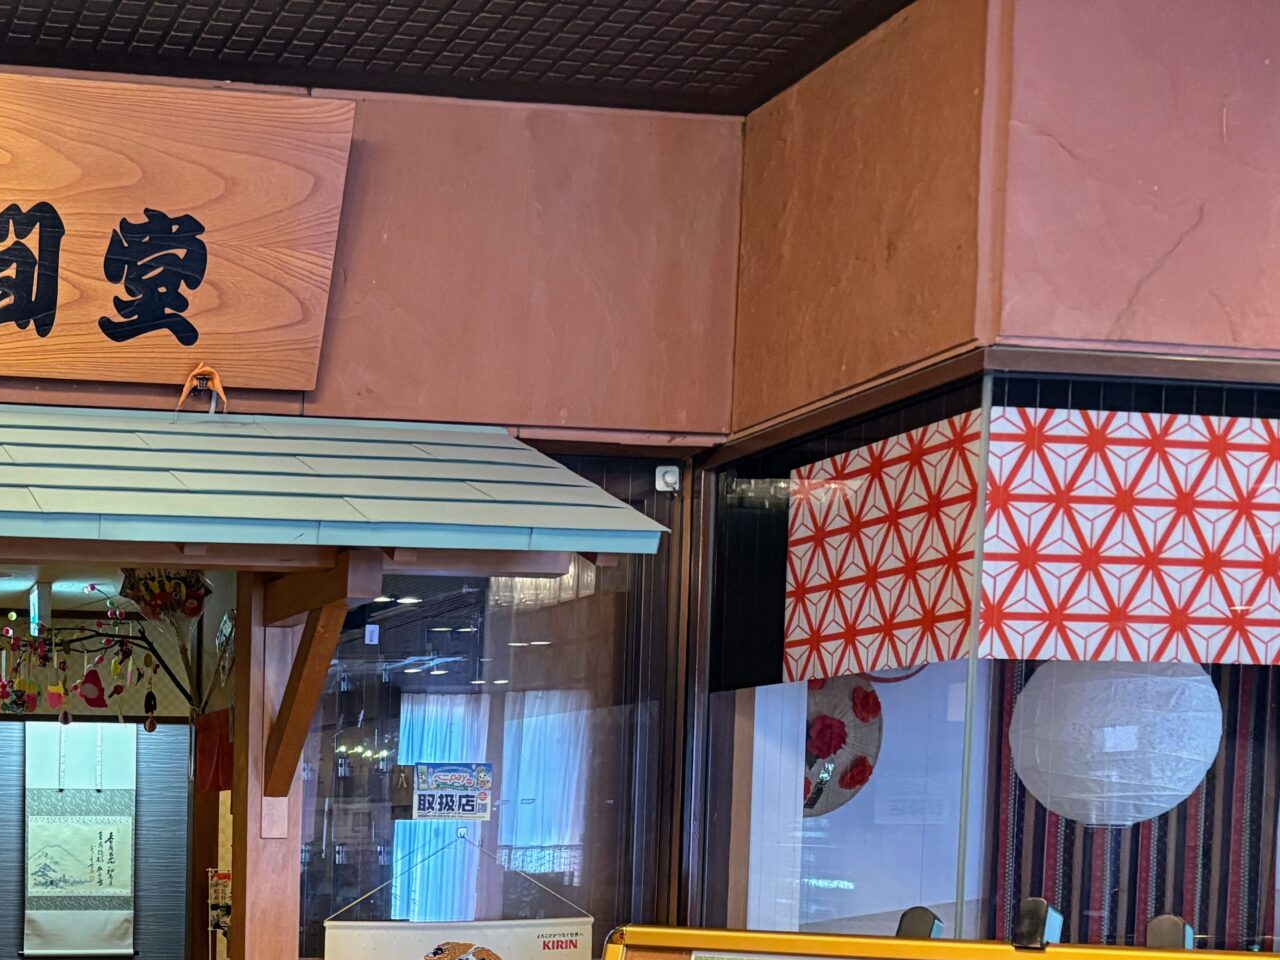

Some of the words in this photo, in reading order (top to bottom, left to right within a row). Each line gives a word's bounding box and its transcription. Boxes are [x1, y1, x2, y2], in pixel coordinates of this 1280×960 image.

[417, 793, 476, 813] 取扱店
[543, 939, 578, 950] KIRIN
